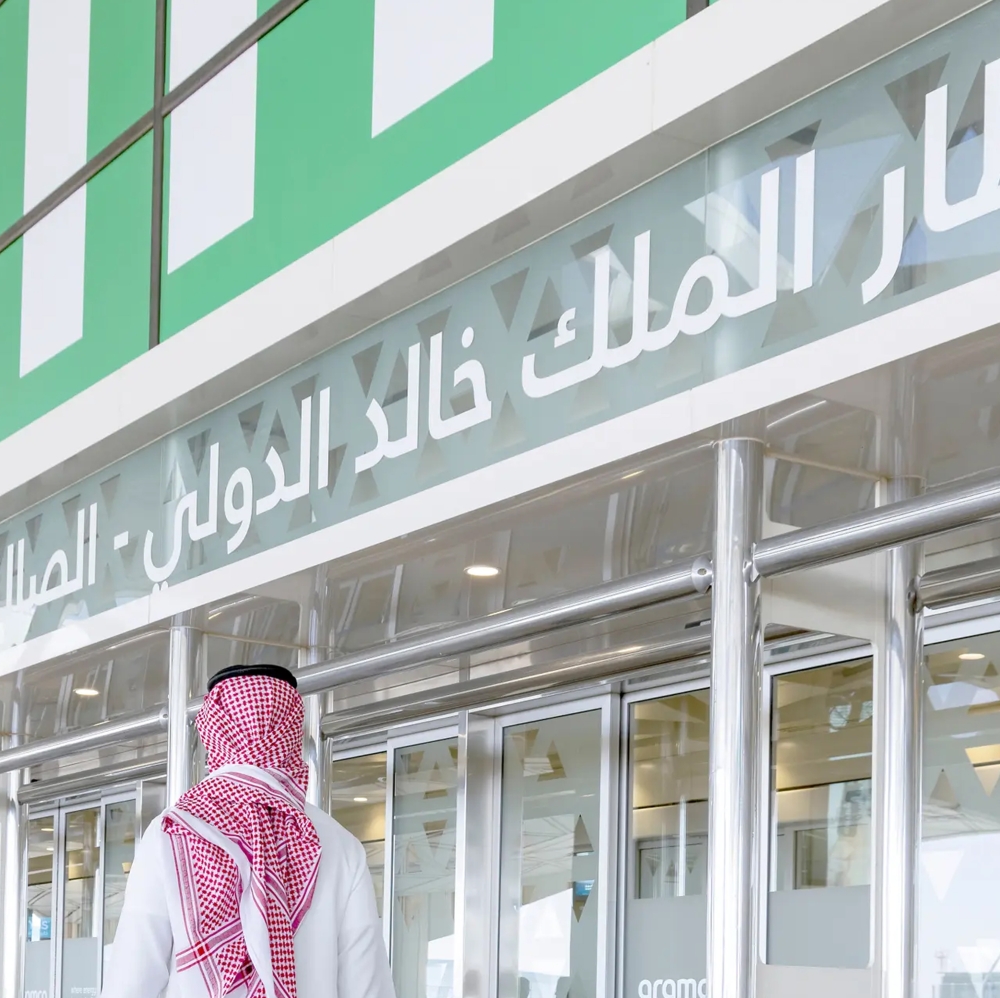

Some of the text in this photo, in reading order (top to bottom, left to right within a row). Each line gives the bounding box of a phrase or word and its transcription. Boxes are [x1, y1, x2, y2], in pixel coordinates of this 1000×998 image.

[521, 149, 815, 398] الملك
[143, 386, 330, 593] الدولي
[355, 326, 492, 474] خالد
